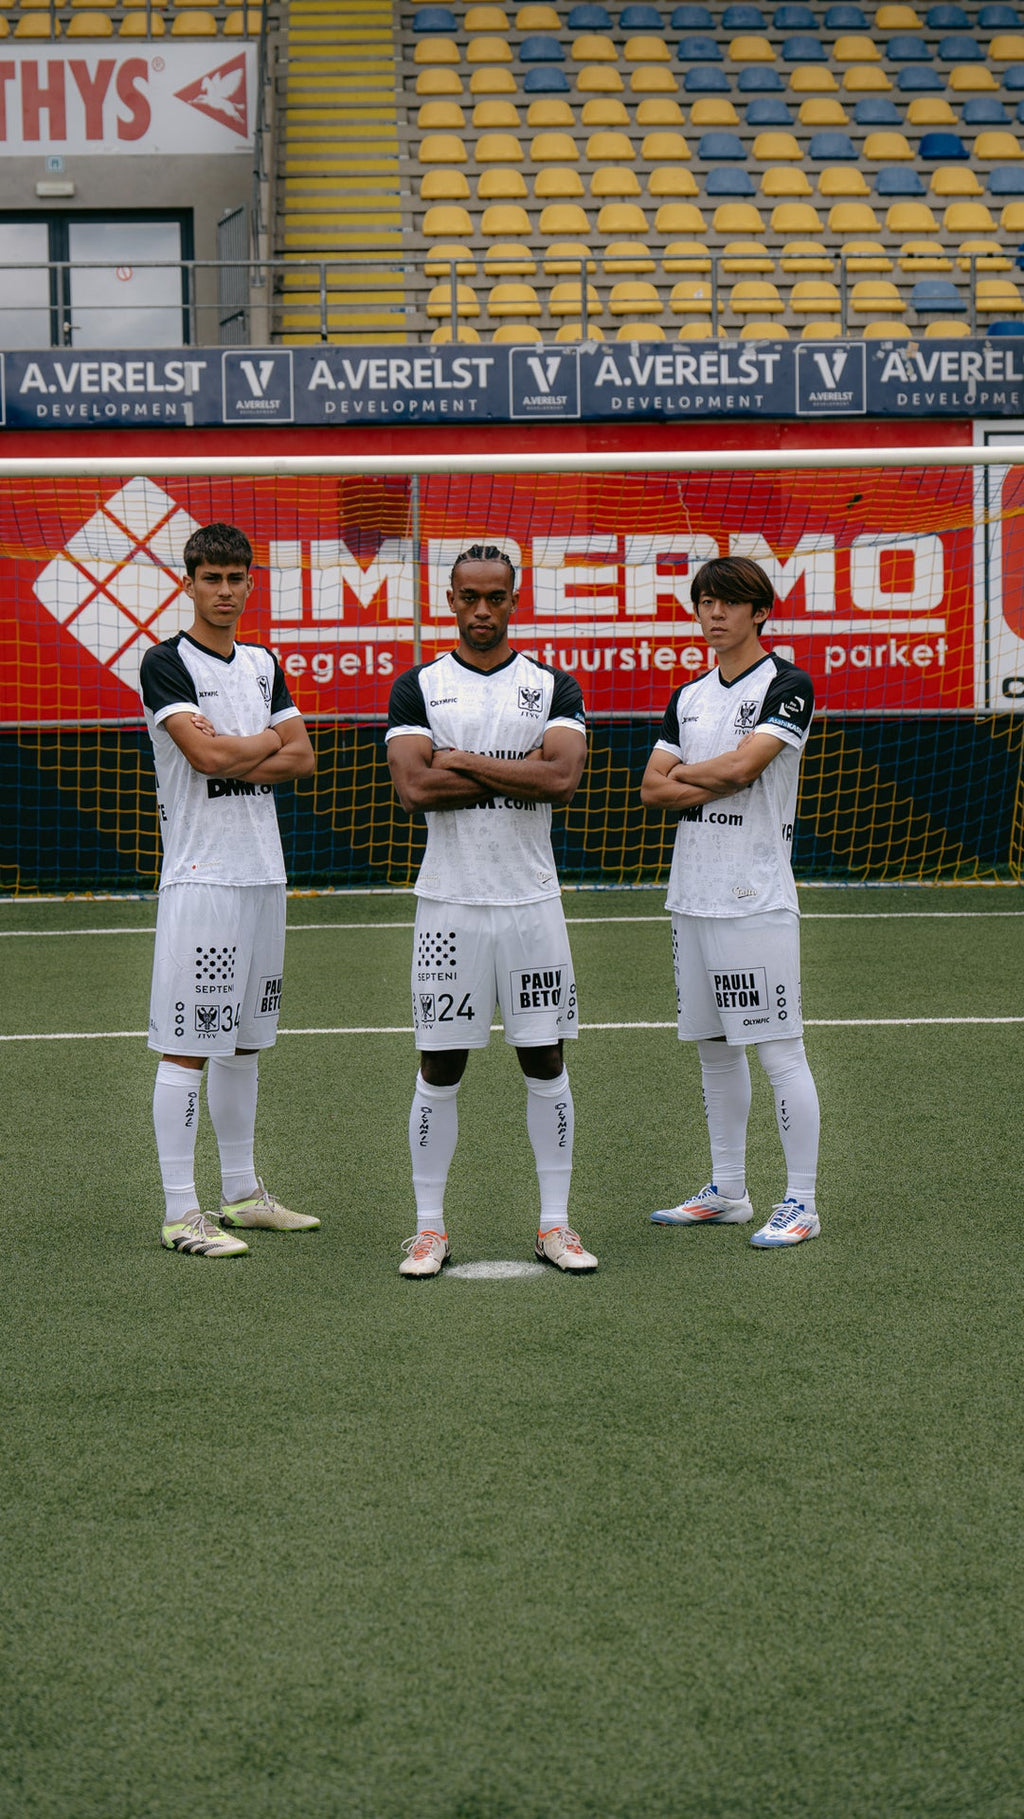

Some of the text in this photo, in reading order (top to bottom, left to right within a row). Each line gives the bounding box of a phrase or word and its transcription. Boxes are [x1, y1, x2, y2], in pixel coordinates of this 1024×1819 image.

[19, 361, 206, 393] A.VERELST
[308, 358, 494, 390] A.VERELST
[594, 353, 781, 387] A.VERELST
[880, 350, 1024, 383] A.VEREL
[325, 399, 477, 414] DEVELOPMENT
[611, 395, 763, 410] DEVELOPMENT
[808, 391, 853, 401] A.VERELST
[824, 638, 948, 674] parket
[430, 697, 458, 707] OLYMPIC
[418, 972, 457, 982] SEPTENI
[714, 973, 755, 991] PAULI
[438, 993, 475, 1022] 24
[716, 990, 760, 1008] BETON
[743, 1017, 770, 1026] OLYMPIC
[185, 1092, 198, 1127] OLYMPIC
[419, 1106, 433, 1147] OLYMPIC
[555, 1102, 567, 1148] OLYMPIC
